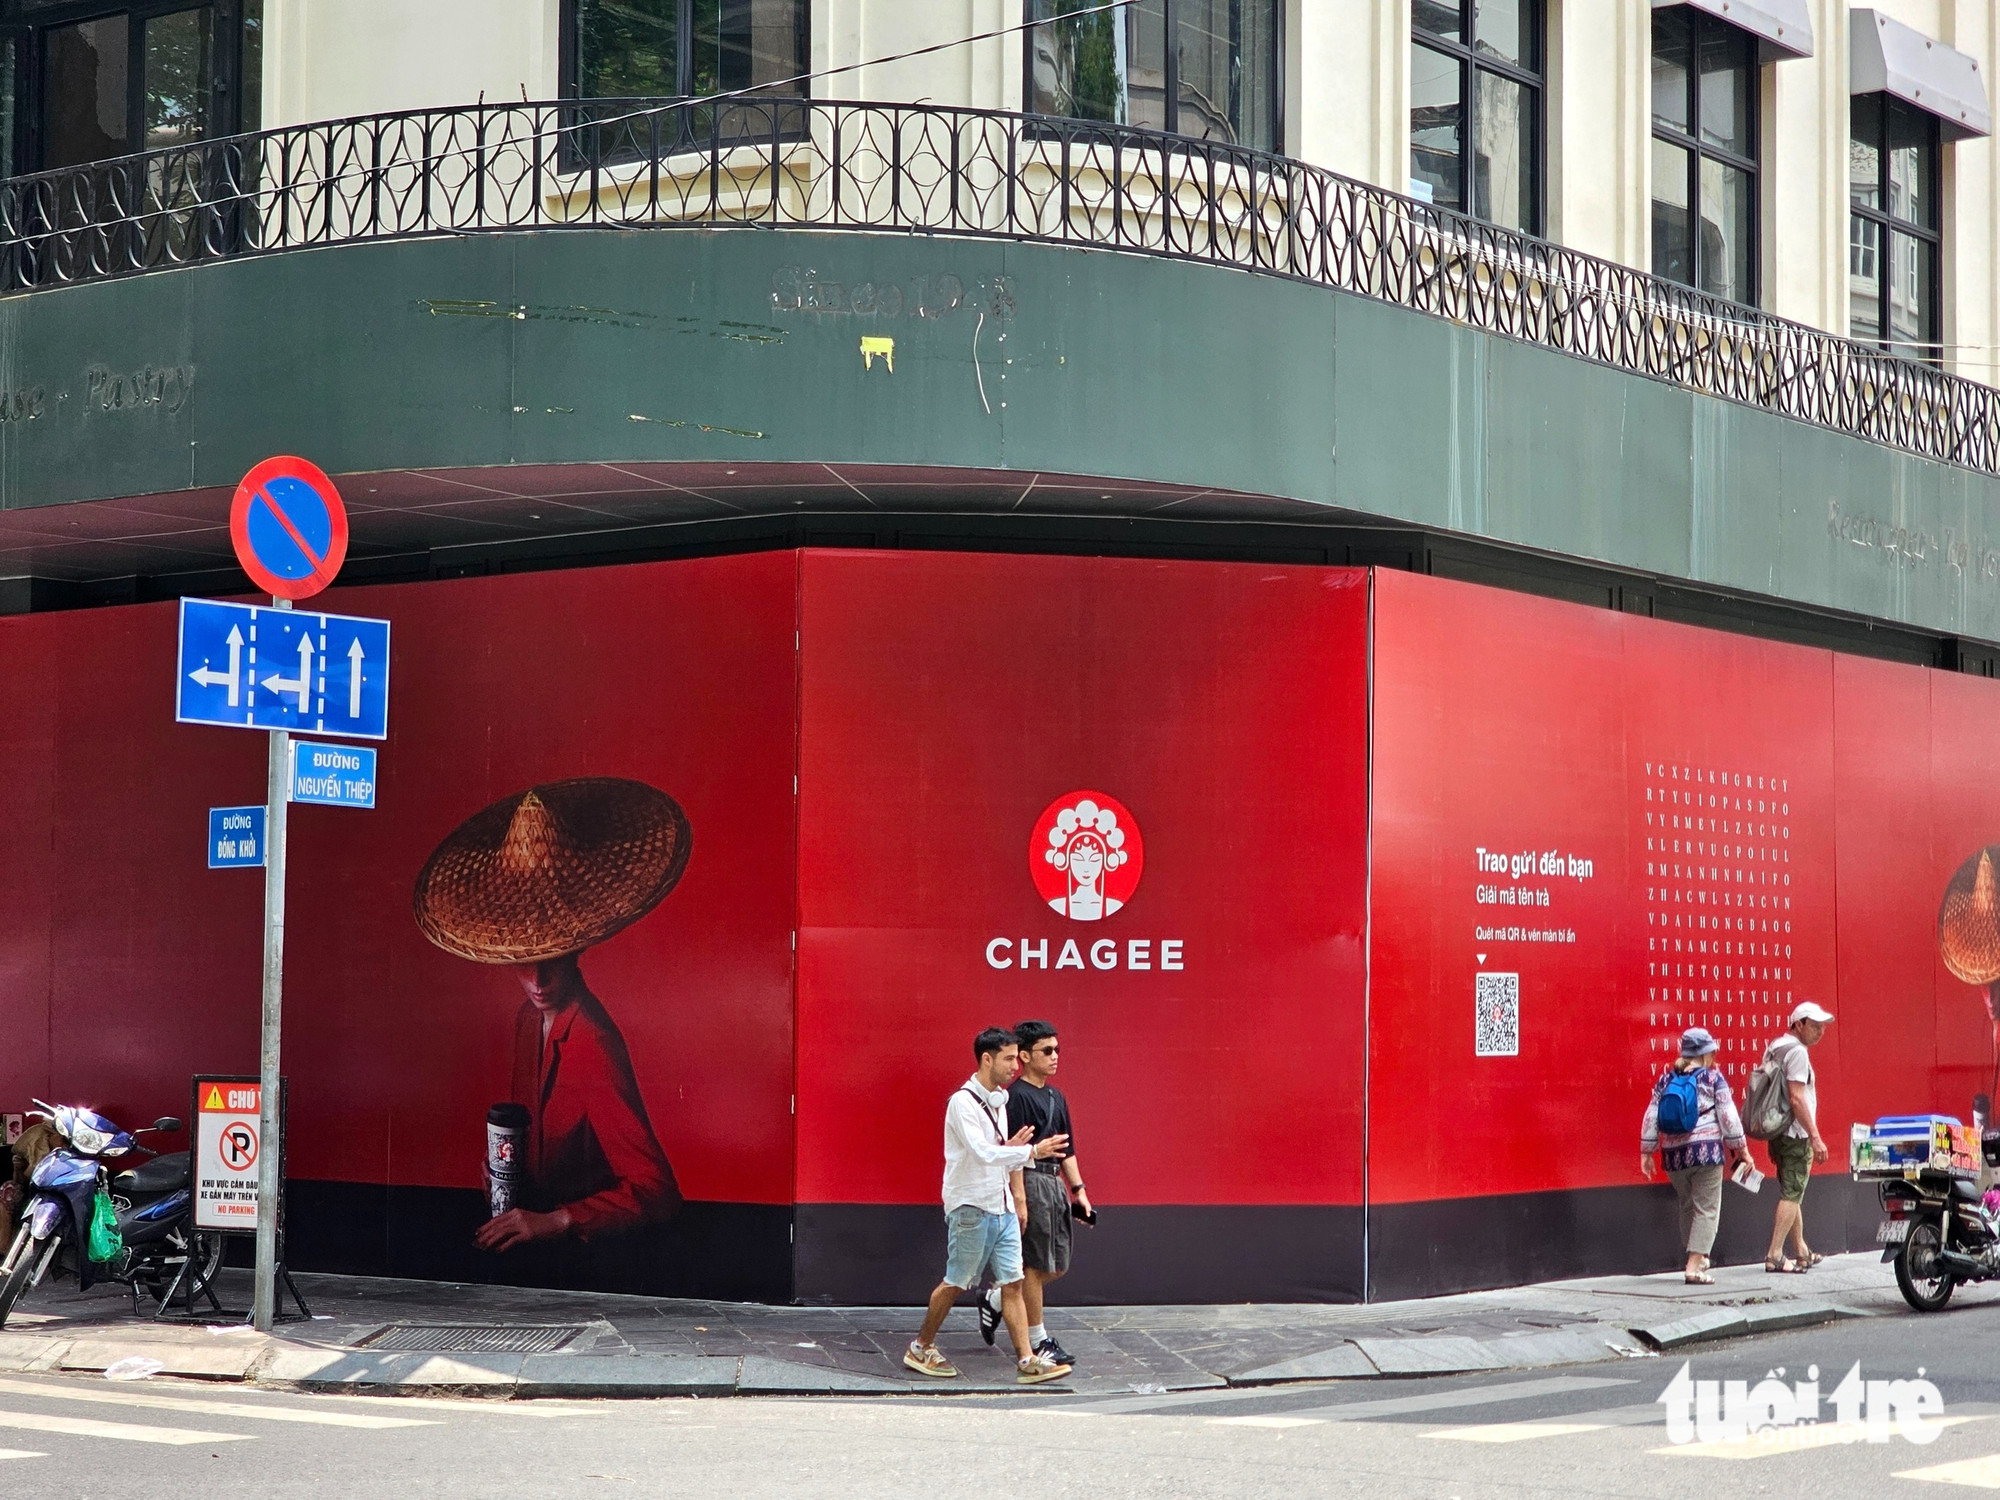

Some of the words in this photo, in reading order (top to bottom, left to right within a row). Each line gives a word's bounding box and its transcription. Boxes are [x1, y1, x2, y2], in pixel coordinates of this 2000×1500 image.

[313, 751, 360, 771] ĐƯỜNG
[297, 773, 341, 798] NGUYỄN
[344, 777, 373, 803] THIỆP
[223, 813, 252, 830] ĐƯỜNG
[239, 831, 256, 858] KHỞI
[1476, 847, 1508, 873] Trao
[1511, 851, 1536, 879] gửi
[1539, 849, 1565, 877] đến
[1568, 853, 1593, 883] bạn
[1476, 884, 1497, 904] Giải
[1499, 886, 1516, 905] mã
[1518, 887, 1534, 906] tên
[1536, 887, 1550, 907] trà
[1475, 926, 1494, 942] Quét
[1495, 927, 1506, 941] mã
[1507, 927, 1520, 942] QR
[1521, 928, 1527, 942] &
[1528, 927, 1541, 942] vén
[1542, 929, 1557, 943] màn
[985, 937, 1185, 971] CHAGEE
[227, 1086, 256, 1109] CHÚ
[200, 1190, 208, 1199] XE
[223, 1190, 237, 1200] MÁY
[202, 1179, 215, 1188] KHU
[216, 1179, 229, 1190] VỰC
[217, 1205, 227, 1213] NO
[228, 1205, 255, 1215] PARKING
